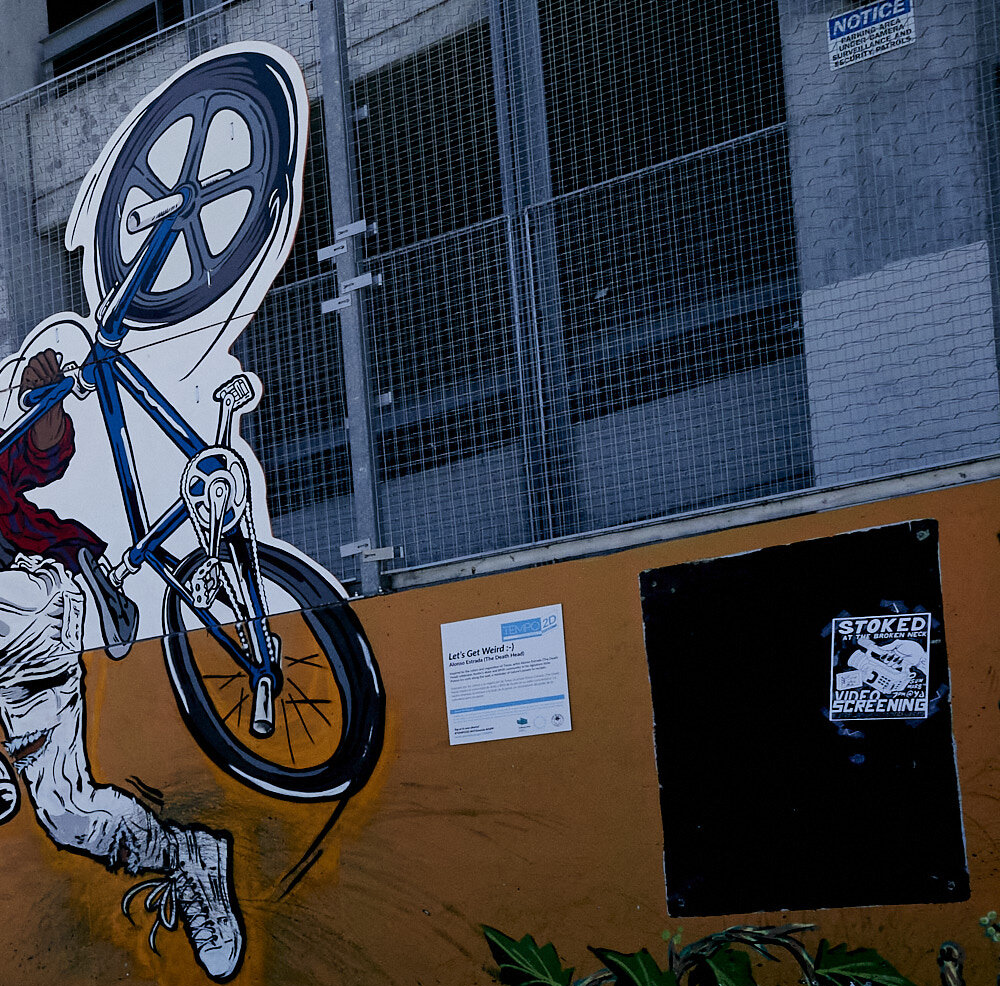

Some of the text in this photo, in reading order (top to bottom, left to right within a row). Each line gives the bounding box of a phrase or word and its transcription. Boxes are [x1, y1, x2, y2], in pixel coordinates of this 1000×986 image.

[833, 0, 905, 36] NOTICE
[838, 24, 904, 52] UNDER CAMERA
[841, 18, 901, 44] PARKING AREA
[832, 28, 912, 61] SURVEILLANCE AND
[834, 37, 911, 68] SECURITY PATROLS
[503, 614, 557, 636] TEMPO 2D
[838, 616, 927, 635] STOKED
[855, 633, 871, 641] THE
[873, 632, 905, 640] BROKEN
[448, 651, 466, 661] Let's
[466, 648, 480, 658] Get
[481, 643, 505, 656] Weird
[465, 657, 483, 666] Estrada
[494, 653, 510, 662] Death
[835, 689, 880, 701] VIDEO
[832, 698, 927, 713] SCREENING
